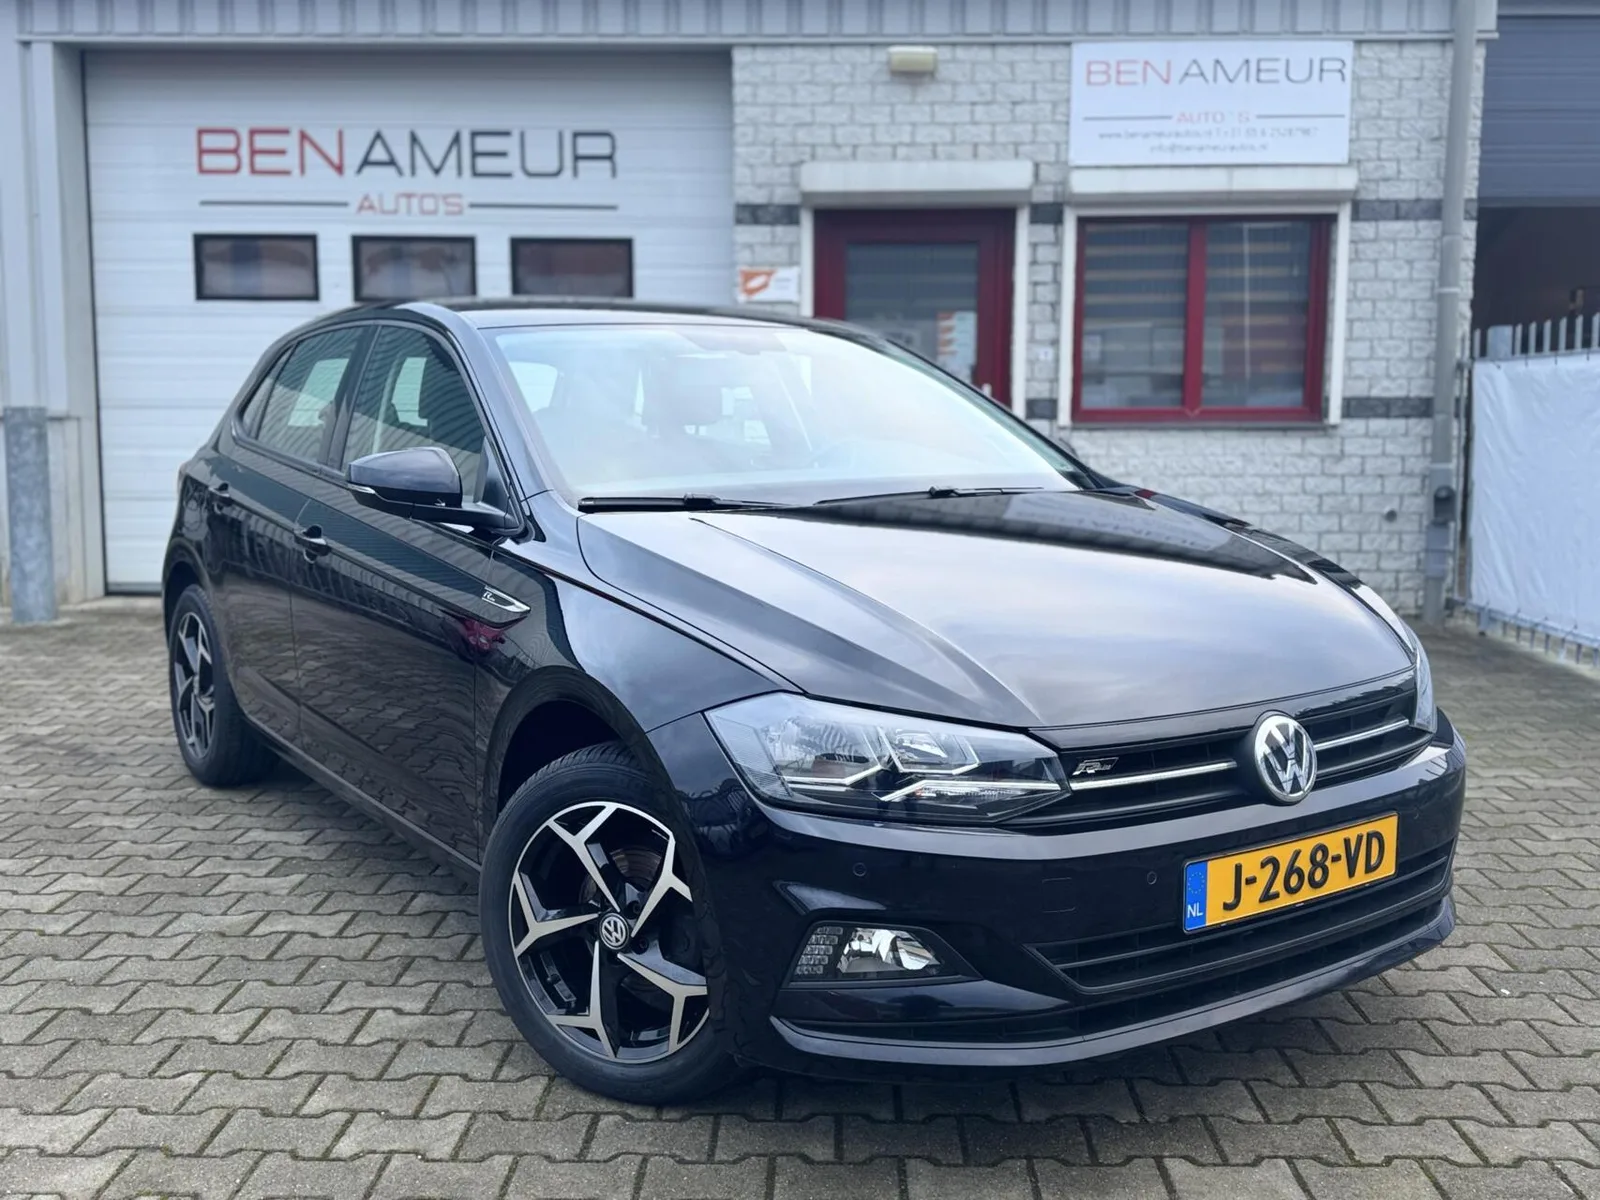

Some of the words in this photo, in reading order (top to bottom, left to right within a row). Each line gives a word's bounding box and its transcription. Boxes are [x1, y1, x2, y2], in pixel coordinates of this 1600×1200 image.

[356, 193, 464, 216] AUTO'S
[1222, 829, 1386, 911] J-268-VD
[1187, 902, 1203, 918] NL
